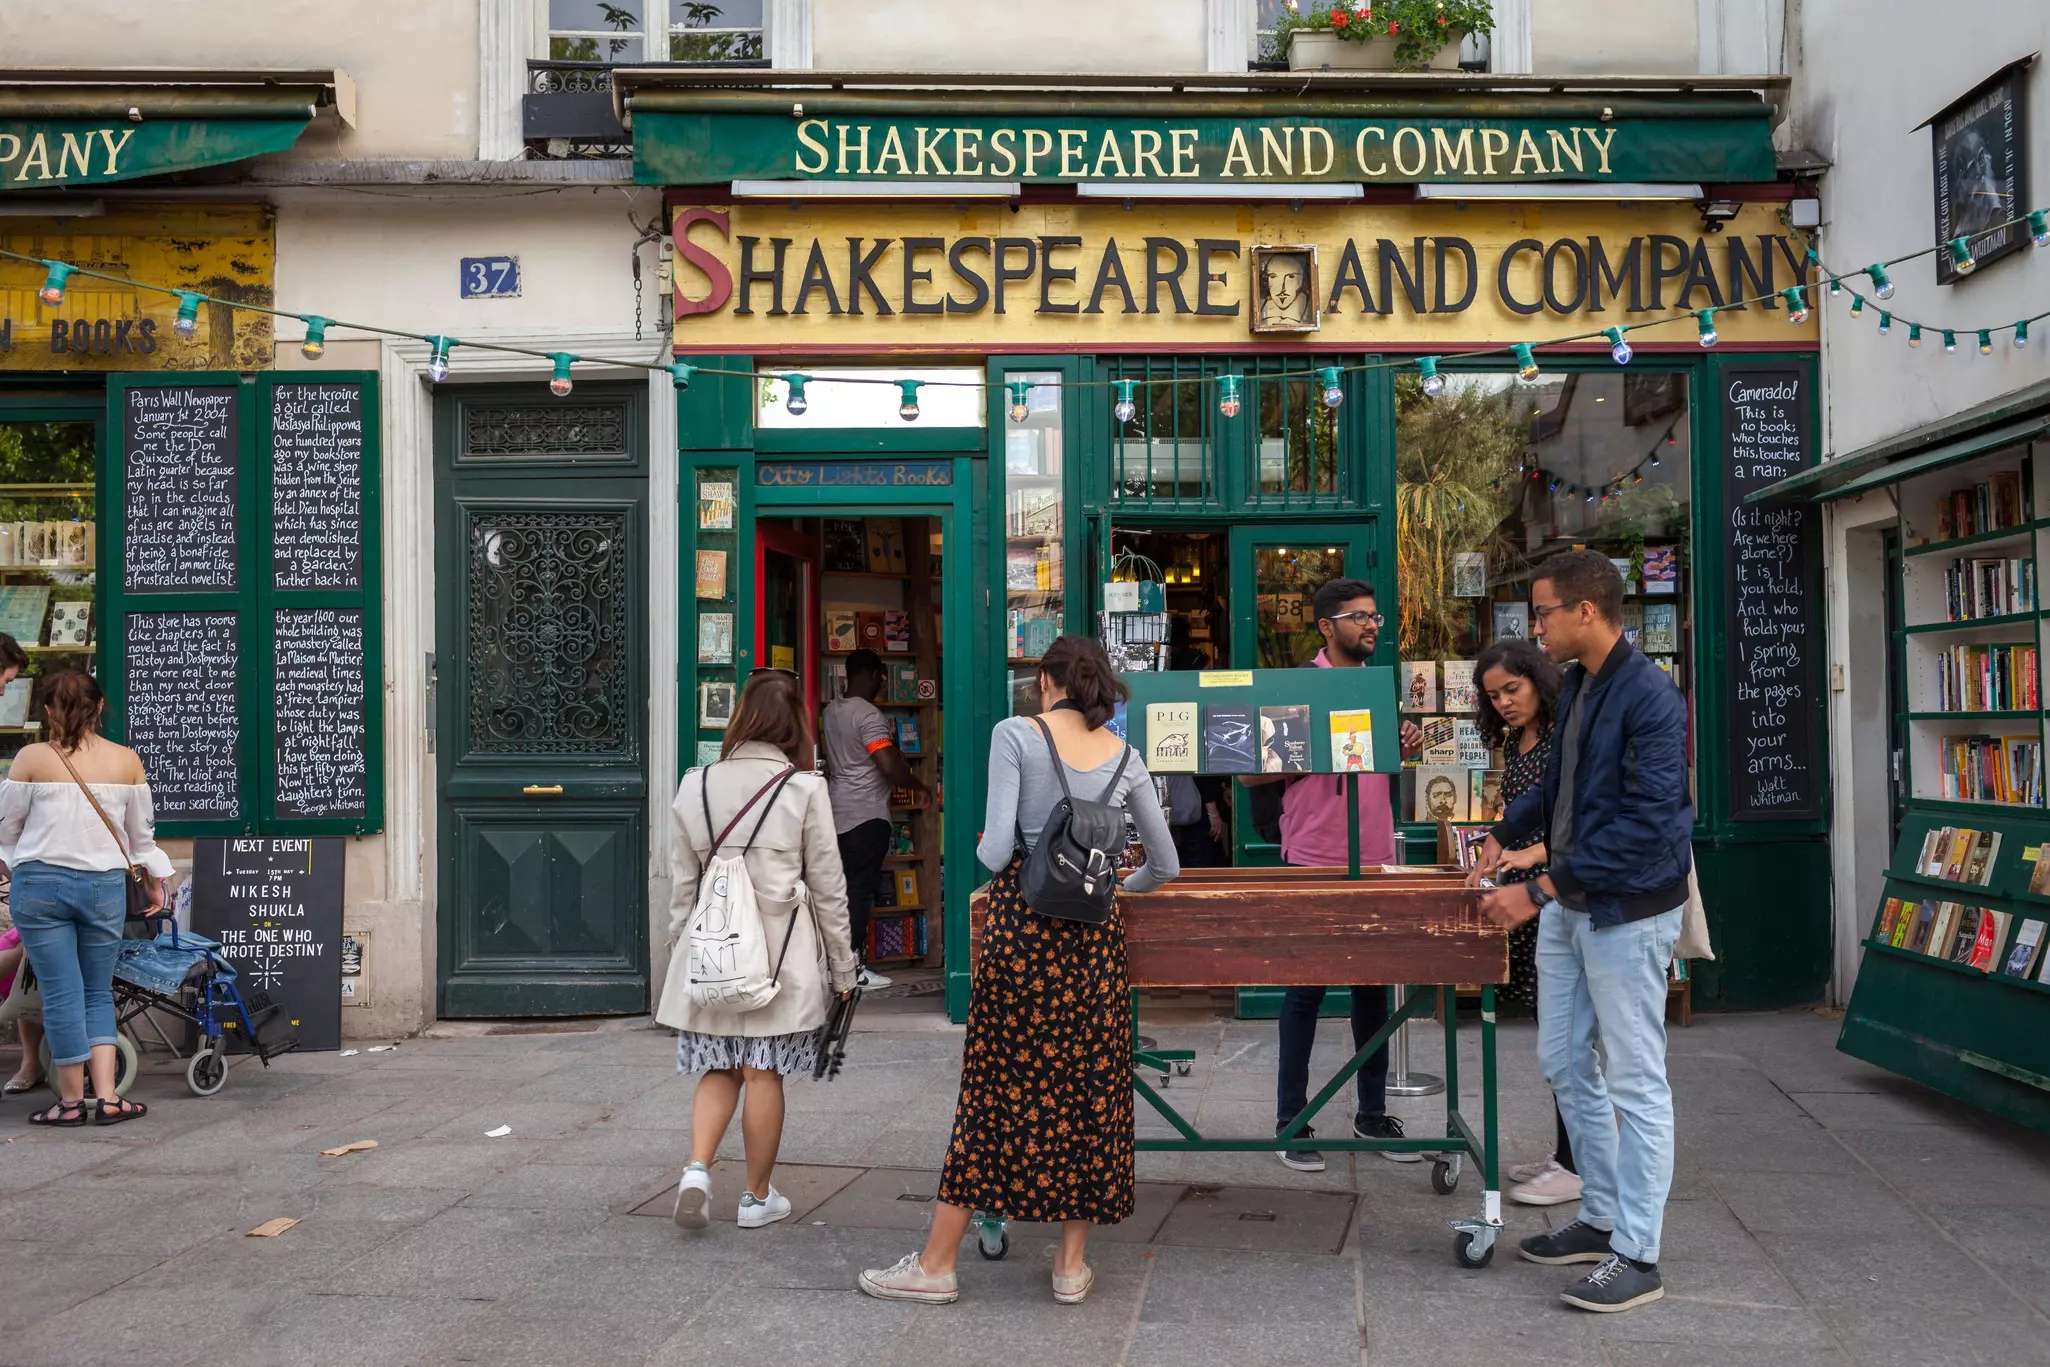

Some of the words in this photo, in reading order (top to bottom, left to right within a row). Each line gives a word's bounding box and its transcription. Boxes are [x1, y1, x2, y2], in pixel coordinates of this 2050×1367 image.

[0, 128, 134, 181] PANY
[796, 120, 1200, 178] SHAKESPEARE
[1220, 127, 1334, 177] AND
[1356, 126, 1616, 176] COMPANY
[673, 207, 1241, 321] SHAKESPEARE
[1324, 236, 1477, 315] AND
[1498, 235, 1817, 314] COMPANY
[469, 259, 509, 294] 37
[52, 318, 157, 353] BOOKS
[131, 391, 159, 407] Paris
[161, 390, 182, 407] Wall
[184, 389, 231, 411] Newspaper
[276, 385, 293, 401] for
[297, 386, 317, 401] the
[320, 386, 359, 401] heroine
[1729, 380, 1798, 403] Camerado!
[134, 408, 174, 425] January
[177, 408, 189, 422] 1st
[194, 408, 228, 423] 2004
[274, 403, 281, 414] a
[284, 401, 309, 419] girl
[311, 400, 351, 414] called
[1735, 406, 1766, 420] This
[1773, 406, 1785, 418] is
[134, 425, 167, 439] Some
[171, 427, 206, 443] people
[210, 425, 227, 439] call
[1741, 422, 1756, 431] no
[1760, 419, 1796, 432] book;
[144, 443, 158, 451] me
[165, 440, 186, 452] the
[190, 439, 215, 451] Don
[274, 435, 293, 447] One
[296, 433, 336, 447] hundred
[337, 438, 361, 451] years
[1732, 433, 1755, 443] Who
[1757, 432, 1799, 445] touches
[274, 450, 291, 463] ago
[295, 450, 309, 462] my
[313, 447, 360, 460] bookstore
[1733, 446, 1758, 459] this,
[1759, 447, 1800, 461] touches
[759, 466, 813, 486] City
[819, 466, 887, 486] Lights
[893, 465, 949, 486] Books
[1734, 465, 1745, 478] a
[1753, 465, 1787, 477] man;
[1732, 506, 1746, 527] (Is
[1751, 507, 1760, 526] it
[1765, 509, 1802, 532] night?
[1733, 530, 1752, 546] Are
[1756, 534, 1769, 544] we
[1772, 532, 1798, 544] here
[1741, 544, 1793, 563] alone?)
[1737, 564, 1748, 581] It
[1758, 564, 1771, 579] is
[1779, 561, 1783, 579] I
[125, 577, 132, 587] a
[134, 571, 189, 589] frustrated
[191, 571, 236, 586] novelist.
[1739, 585, 1764, 600] you
[1768, 577, 1803, 595] hold,
[1737, 600, 1767, 617] And
[1774, 598, 1798, 615] who
[128, 613, 154, 629] This
[157, 613, 180, 629] store
[183, 614, 201, 627] has
[205, 616, 236, 626] rooms
[128, 629, 152, 641] like
[155, 628, 204, 644] chapters
[208, 627, 217, 638] in
[222, 629, 230, 638] a
[1744, 618, 1778, 636] holds
[1781, 623, 1805, 642] you;
[128, 641, 156, 653] novel
[160, 640, 179, 653] and
[183, 640, 199, 652] the
[201, 640, 221, 653] fact
[226, 640, 236, 651] is
[1740, 641, 1745, 661] I
[1754, 643, 1800, 667] spring
[1749, 660, 1786, 683] from
[1738, 682, 1760, 700] the
[1764, 684, 1801, 707] pages
[1752, 708, 1786, 729] into
[1430, 748, 1454, 756] sharp
[1747, 733, 1786, 756] your
[284, 747, 307, 762] have
[309, 749, 330, 761] been
[333, 750, 364, 764] doing
[1460, 752, 1486, 760] PEOPLE
[1748, 754, 1806, 774] arms...
[278, 763, 298, 775] this
[300, 761, 313, 778] for
[315, 761, 336, 779] fifty
[338, 763, 366, 777] years.
[279, 775, 302, 789] Now
[305, 773, 315, 786] it
[320, 774, 329, 784] is
[335, 776, 355, 789] my
[1758, 776, 1787, 793] Walt
[338, 786, 365, 799] turn.
[1750, 791, 1800, 806] Whitman
[330, 799, 365, 811] Whitman
[233, 839, 264, 852] NEXT
[273, 839, 310, 852] EVENT
[230, 885, 291, 898] NIKESH
[249, 904, 305, 917] SHUKLA
[221, 930, 247, 943] THE
[254, 929, 279, 942] ONE
[283, 929, 312, 942] WHO
[220, 945, 263, 958] WROTE
[269, 943, 324, 957] DESTINY
